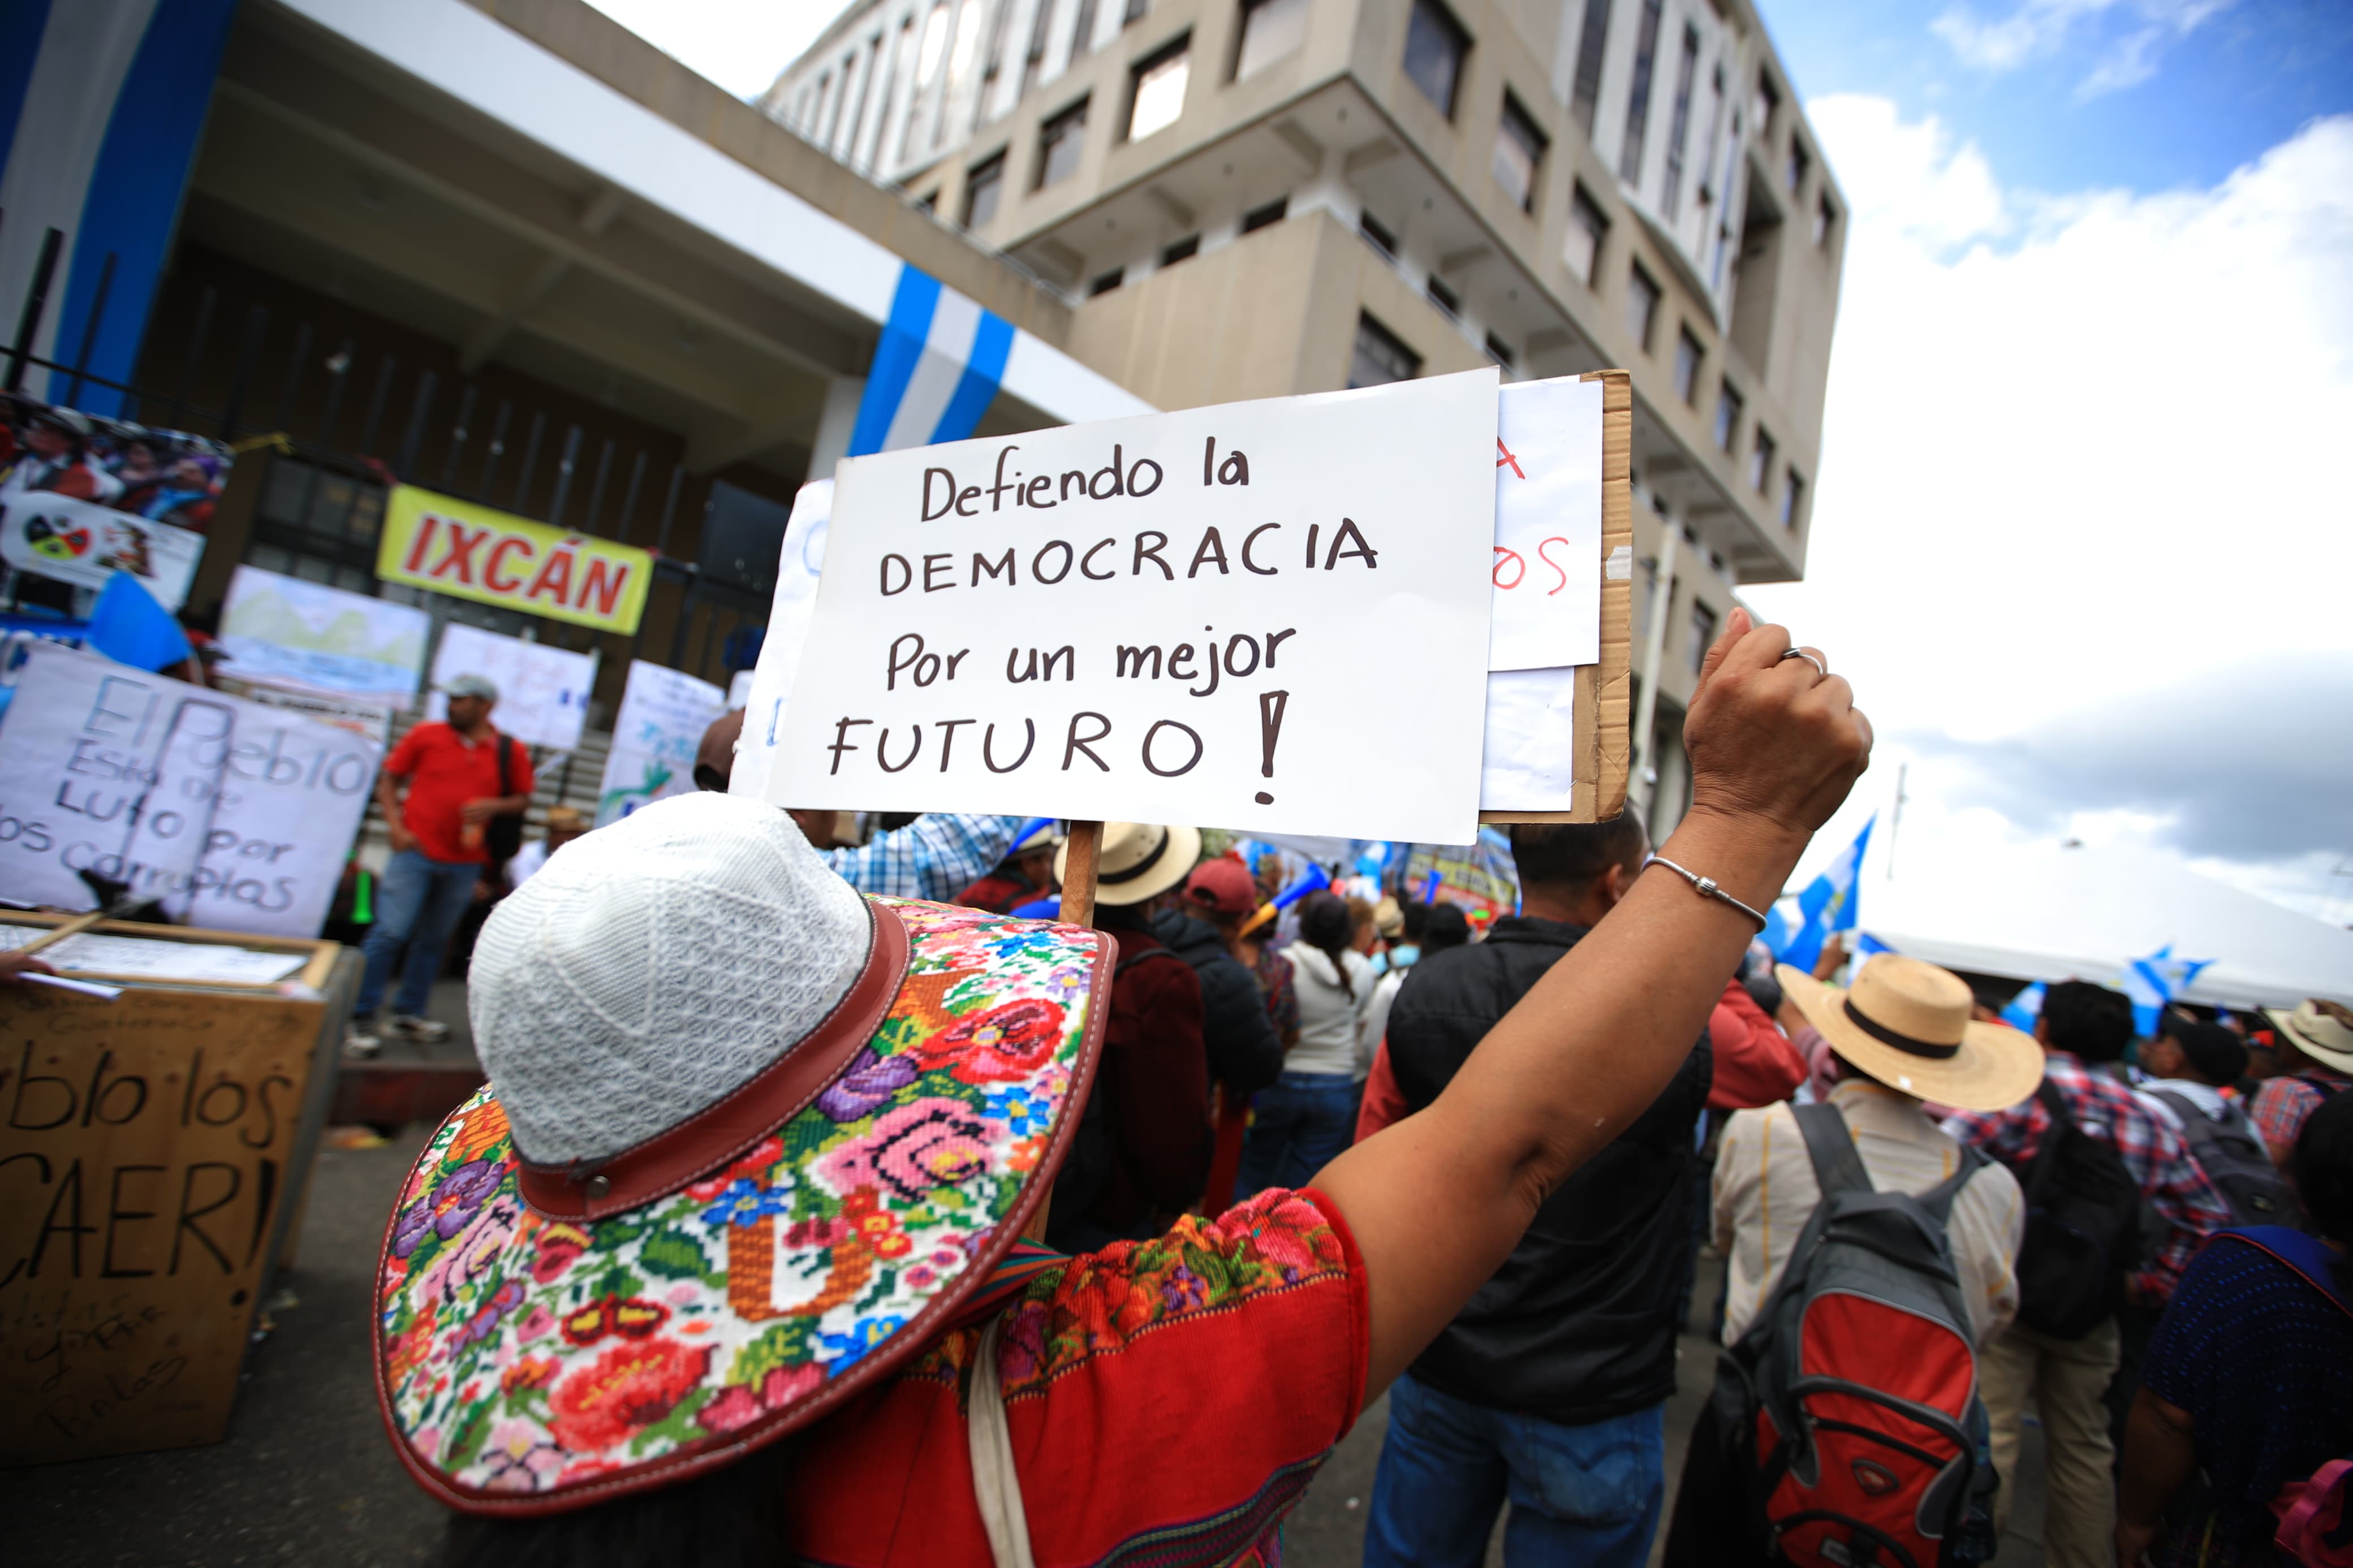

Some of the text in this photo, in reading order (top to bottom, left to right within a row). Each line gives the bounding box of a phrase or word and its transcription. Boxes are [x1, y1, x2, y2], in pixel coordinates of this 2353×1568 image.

[921, 436, 1249, 522] Defiendo la
[404, 519, 629, 617] IXCÁN
[880, 517, 1378, 596] DEMOCRACIA
[887, 625, 1296, 697] Por un mejor
